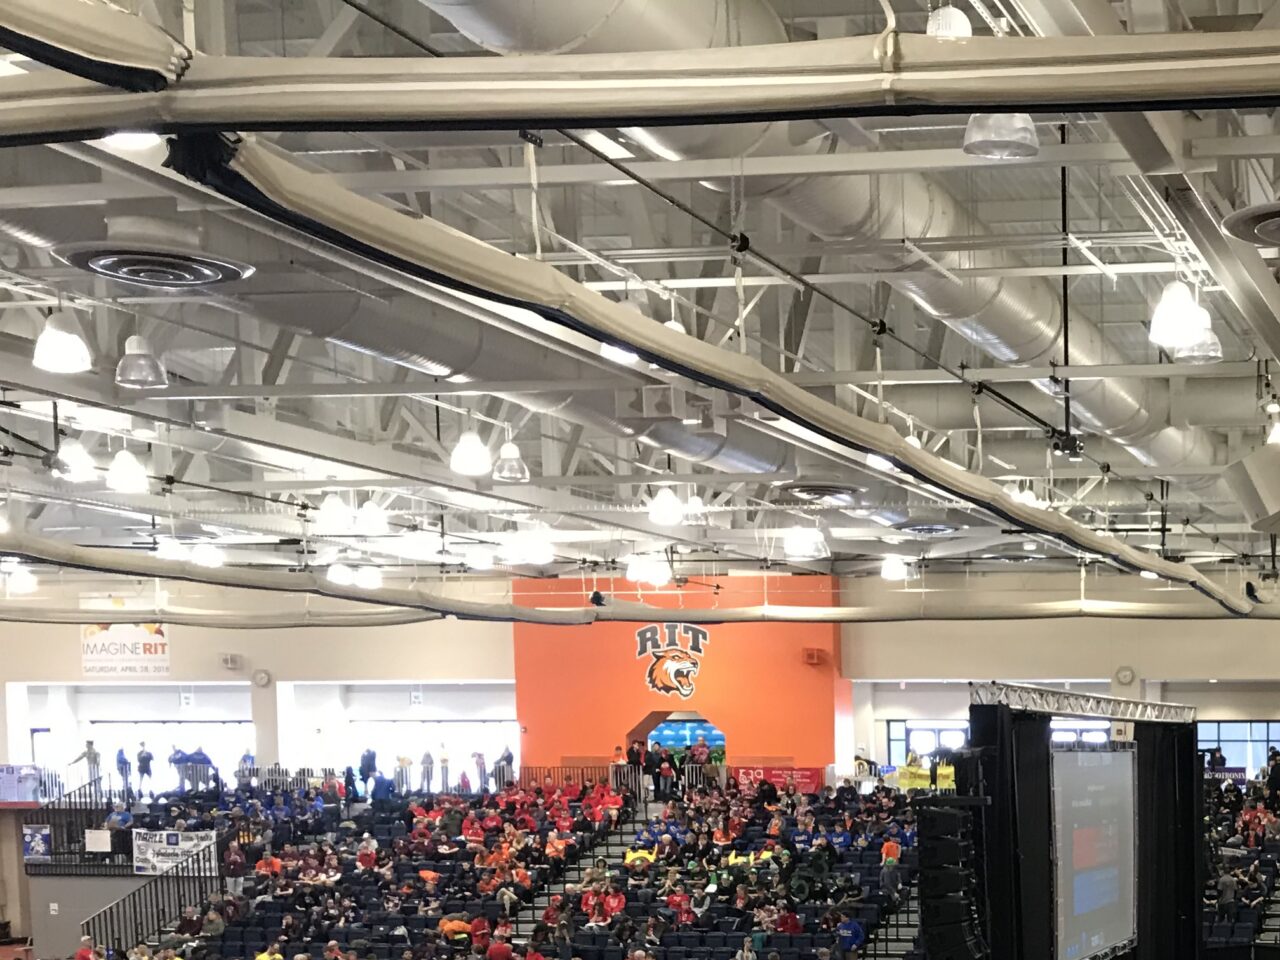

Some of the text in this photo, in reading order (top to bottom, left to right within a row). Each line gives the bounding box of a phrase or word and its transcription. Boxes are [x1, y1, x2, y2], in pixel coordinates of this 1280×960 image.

[82, 642, 167, 655] IMAGINE RIT
[635, 622, 709, 659] RIT
